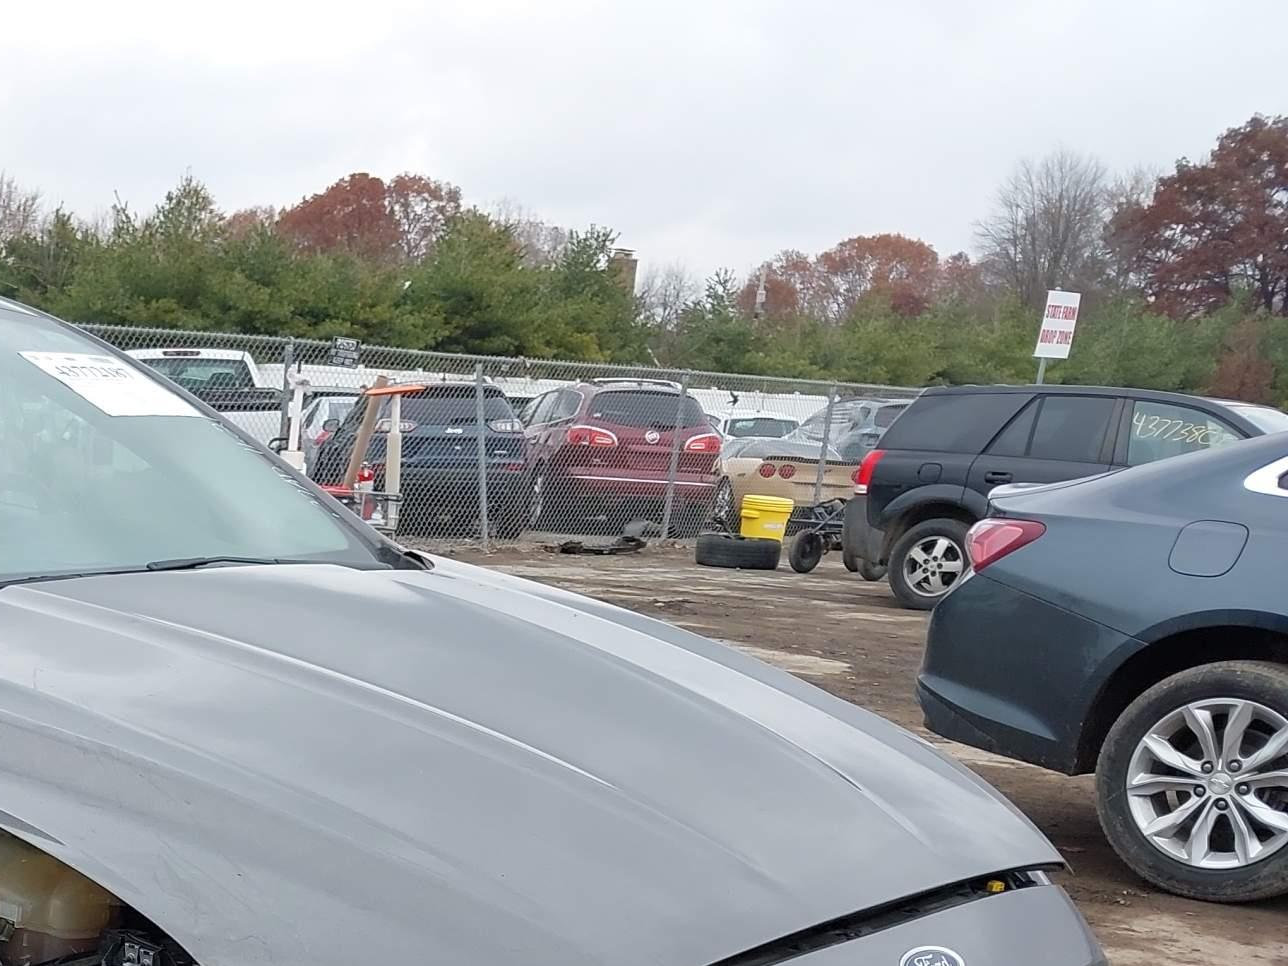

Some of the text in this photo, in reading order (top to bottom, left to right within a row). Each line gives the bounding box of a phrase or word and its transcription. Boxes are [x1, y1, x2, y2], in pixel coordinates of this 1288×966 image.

[1045, 304, 1078, 321] STATE FARM
[1040, 329, 1073, 345] DROP ZONE
[444, 427, 464, 435] Jeep
